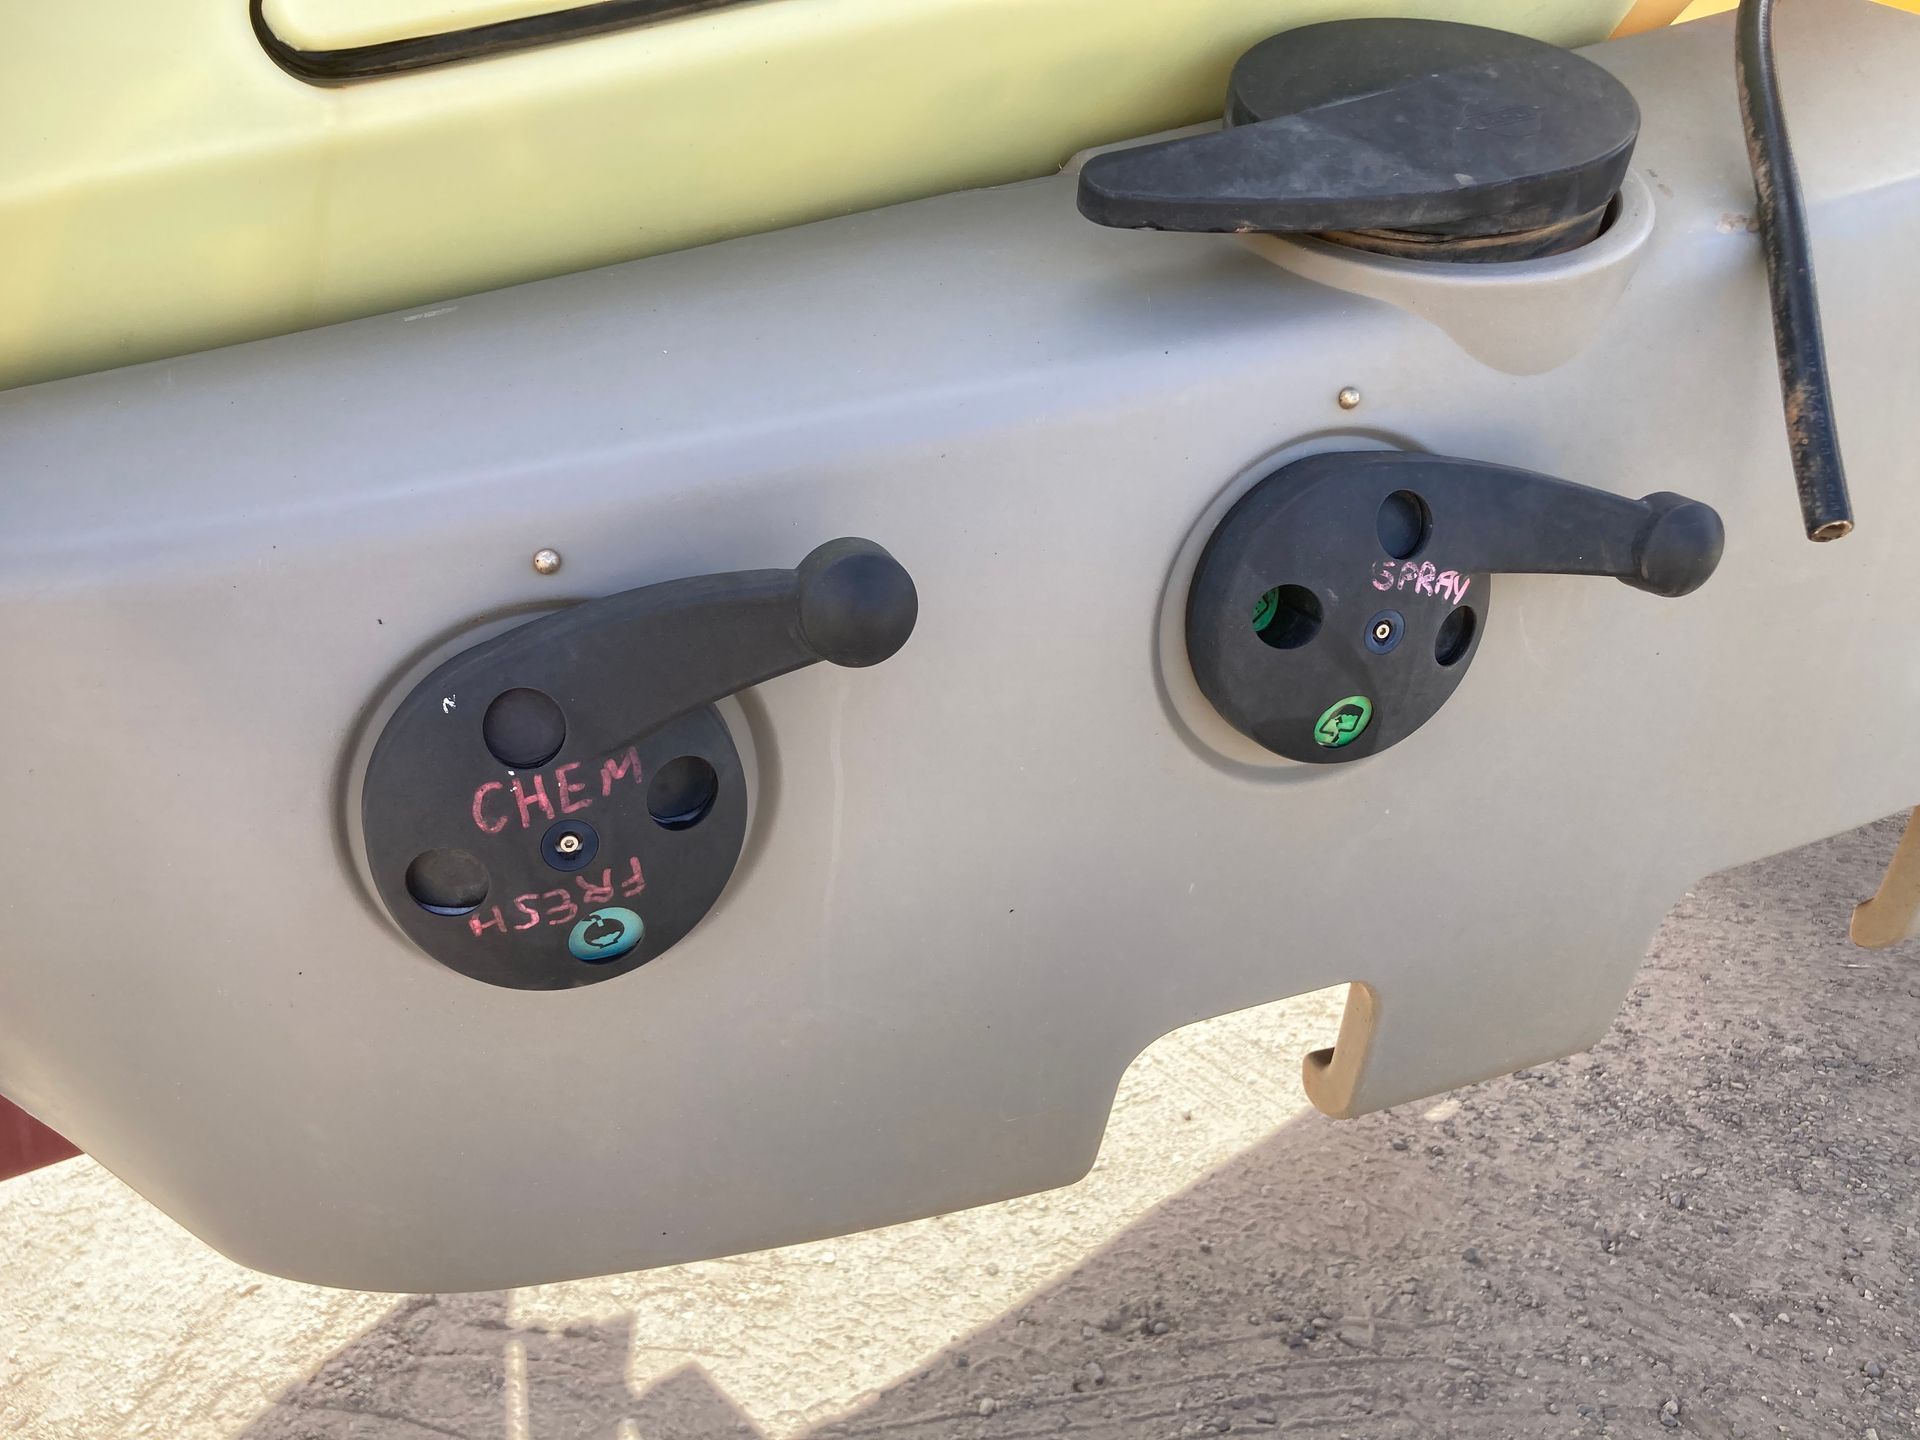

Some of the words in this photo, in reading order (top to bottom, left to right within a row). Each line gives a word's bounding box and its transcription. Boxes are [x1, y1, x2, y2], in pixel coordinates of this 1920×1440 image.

[1372, 560, 1471, 605] SPRAY
[472, 746, 643, 834] CHEM
[469, 856, 648, 937] FRESH
